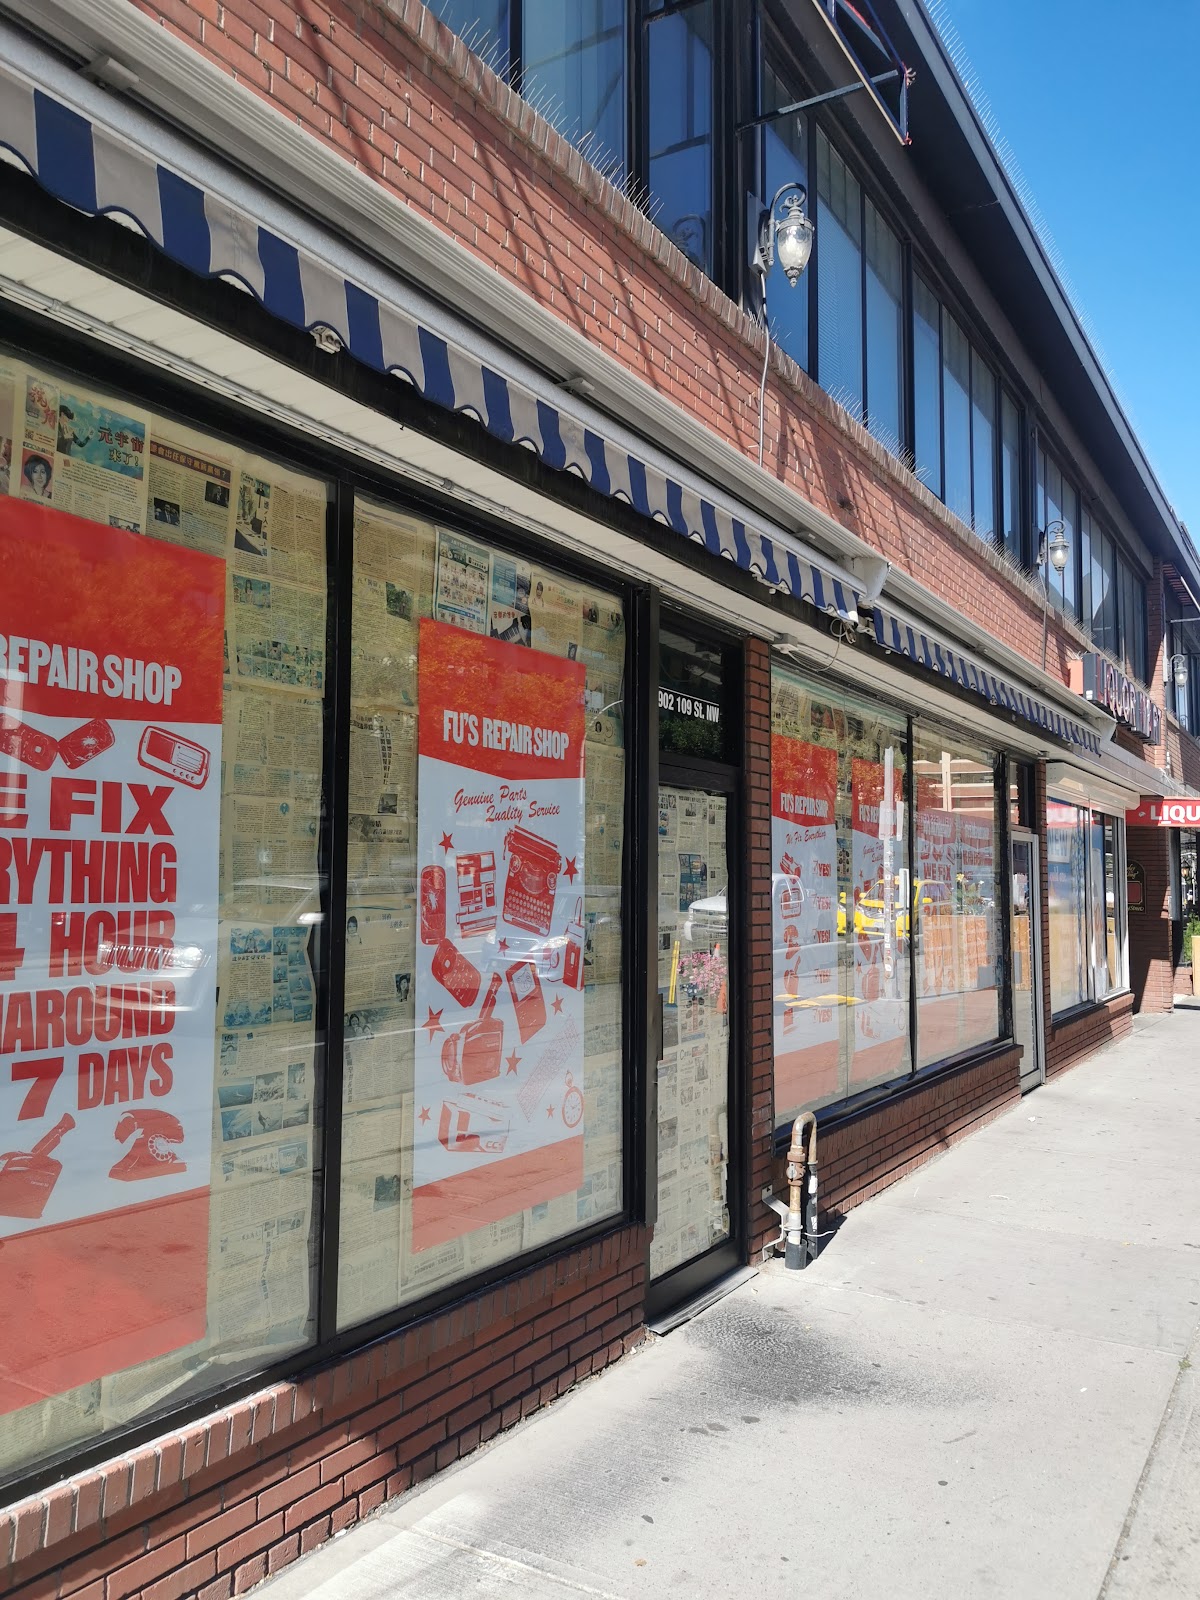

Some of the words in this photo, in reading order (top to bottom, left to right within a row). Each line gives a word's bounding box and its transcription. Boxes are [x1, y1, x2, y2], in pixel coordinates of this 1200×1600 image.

[102, 654, 183, 706] SHOP
[658, 690, 675, 711] 902
[676, 696, 692, 715] 109
[693, 701, 705, 719] St.
[706, 704, 720, 723] NW
[443, 709, 479, 747] FU'S
[482, 717, 533, 755] REPAIR
[533, 727, 570, 760] SHOP
[0, 771, 29, 829] E
[50, 776, 175, 836] FIX
[453, 788, 495, 813] Genuine
[499, 784, 527, 804] Parts
[485, 804, 524, 826] Quality
[528, 800, 561, 818] Service
[780, 792, 794, 813] FU'S
[794, 795, 816, 816] REPAIR
[1150, 804, 1200, 824] LIQU
[818, 863, 831, 877] YES!
[48, 909, 176, 978] HOUR
[817, 929, 831, 943] YES!
[0, 980, 176, 1054] AROUND
[11, 1056, 64, 1122] 7
[77, 1042, 174, 1111] DAYS
